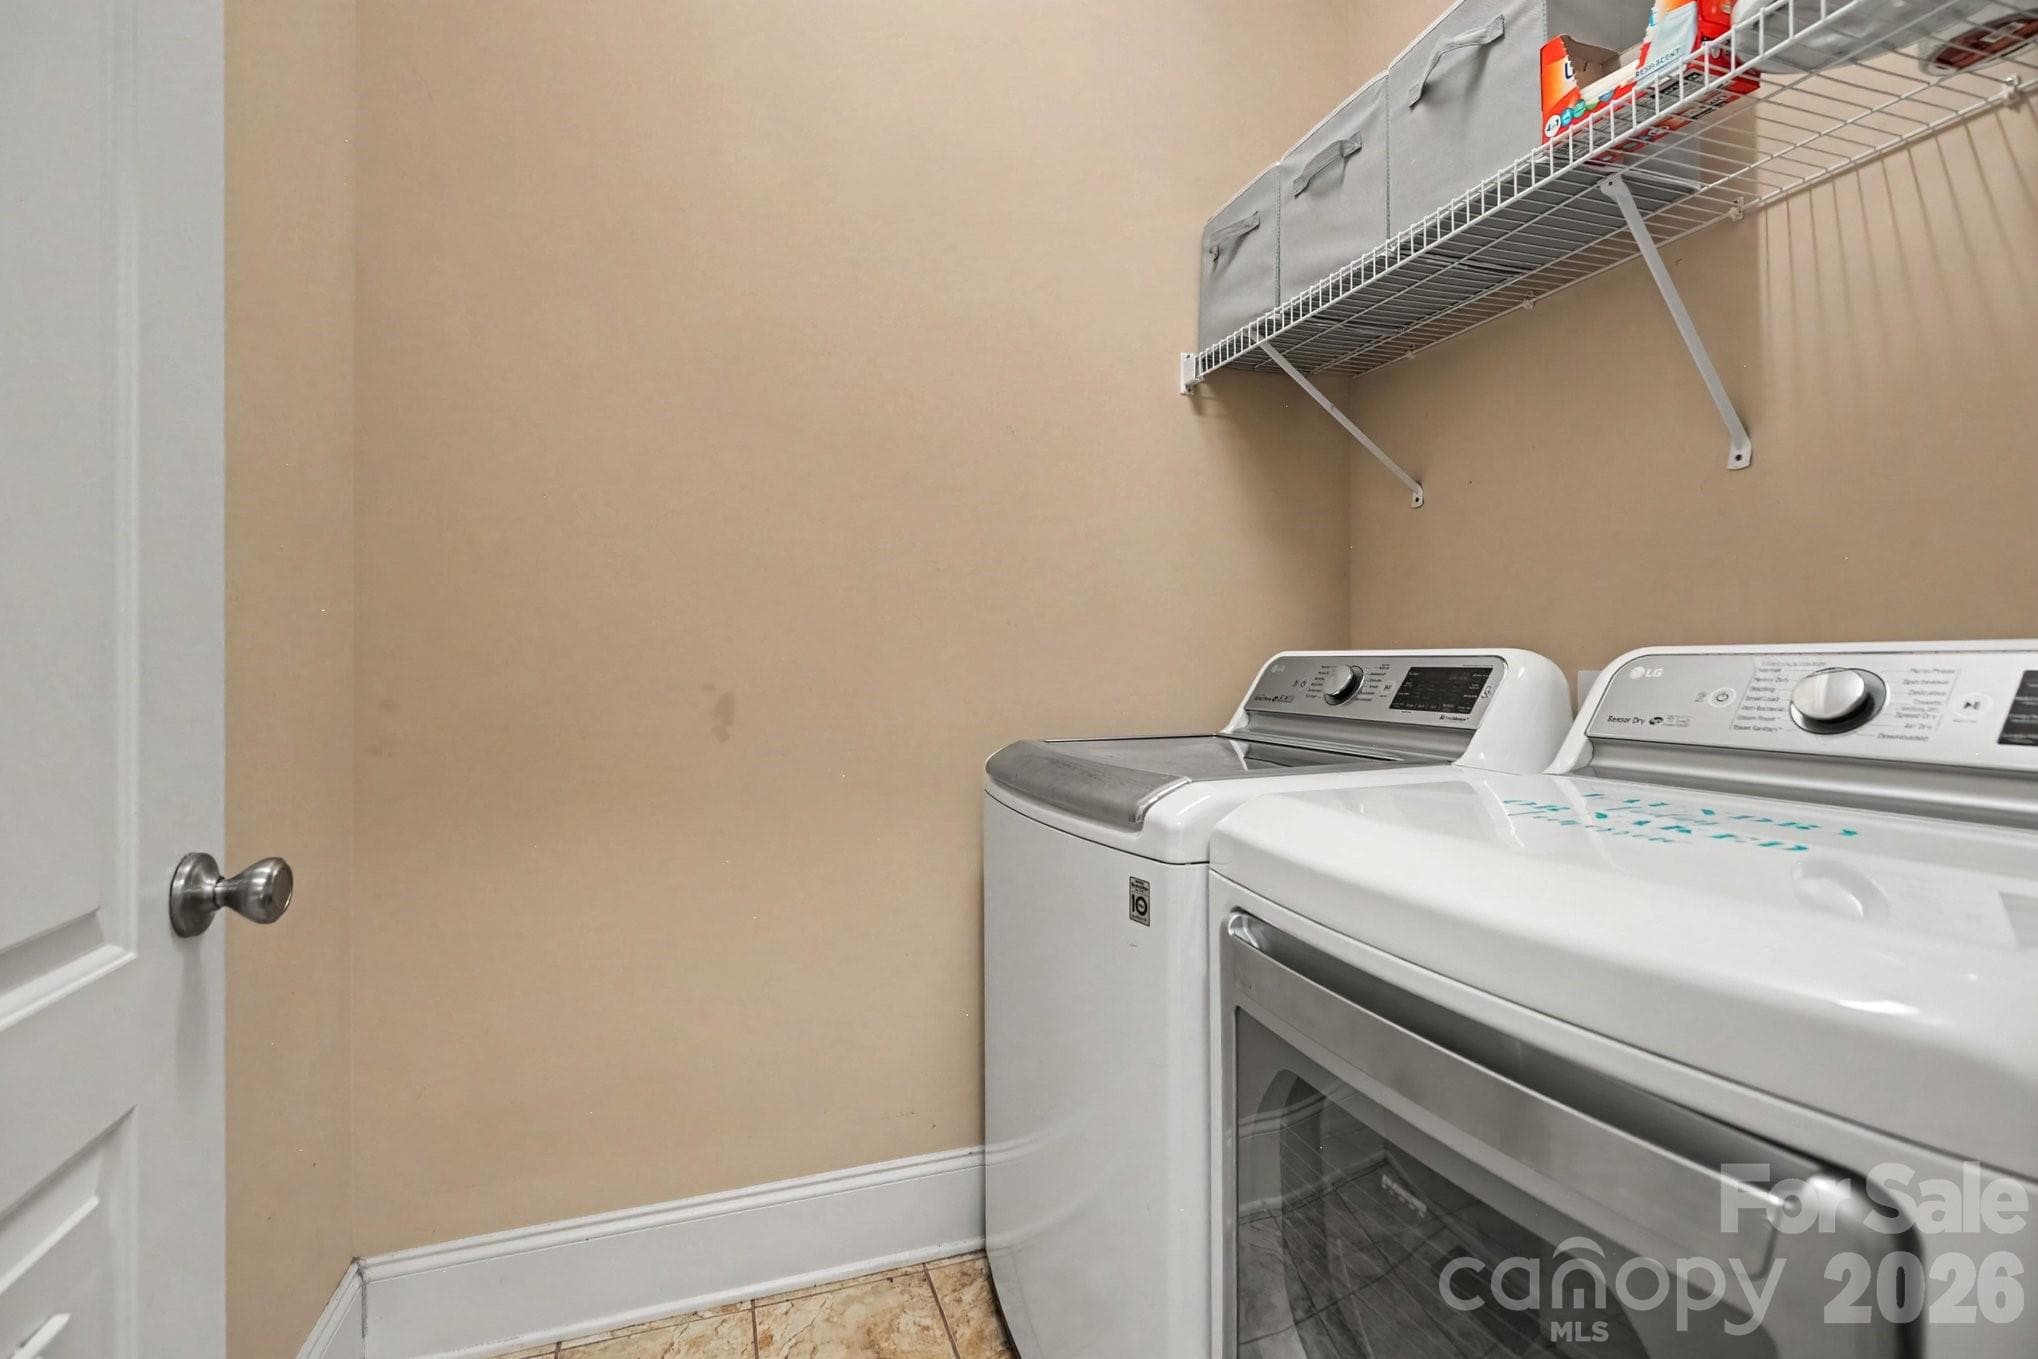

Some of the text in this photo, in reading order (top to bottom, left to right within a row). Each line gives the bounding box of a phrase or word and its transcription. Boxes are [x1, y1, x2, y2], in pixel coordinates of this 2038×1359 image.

[1608, 715, 1645, 726] Sensor Dry
[1131, 894, 1148, 916] 10
